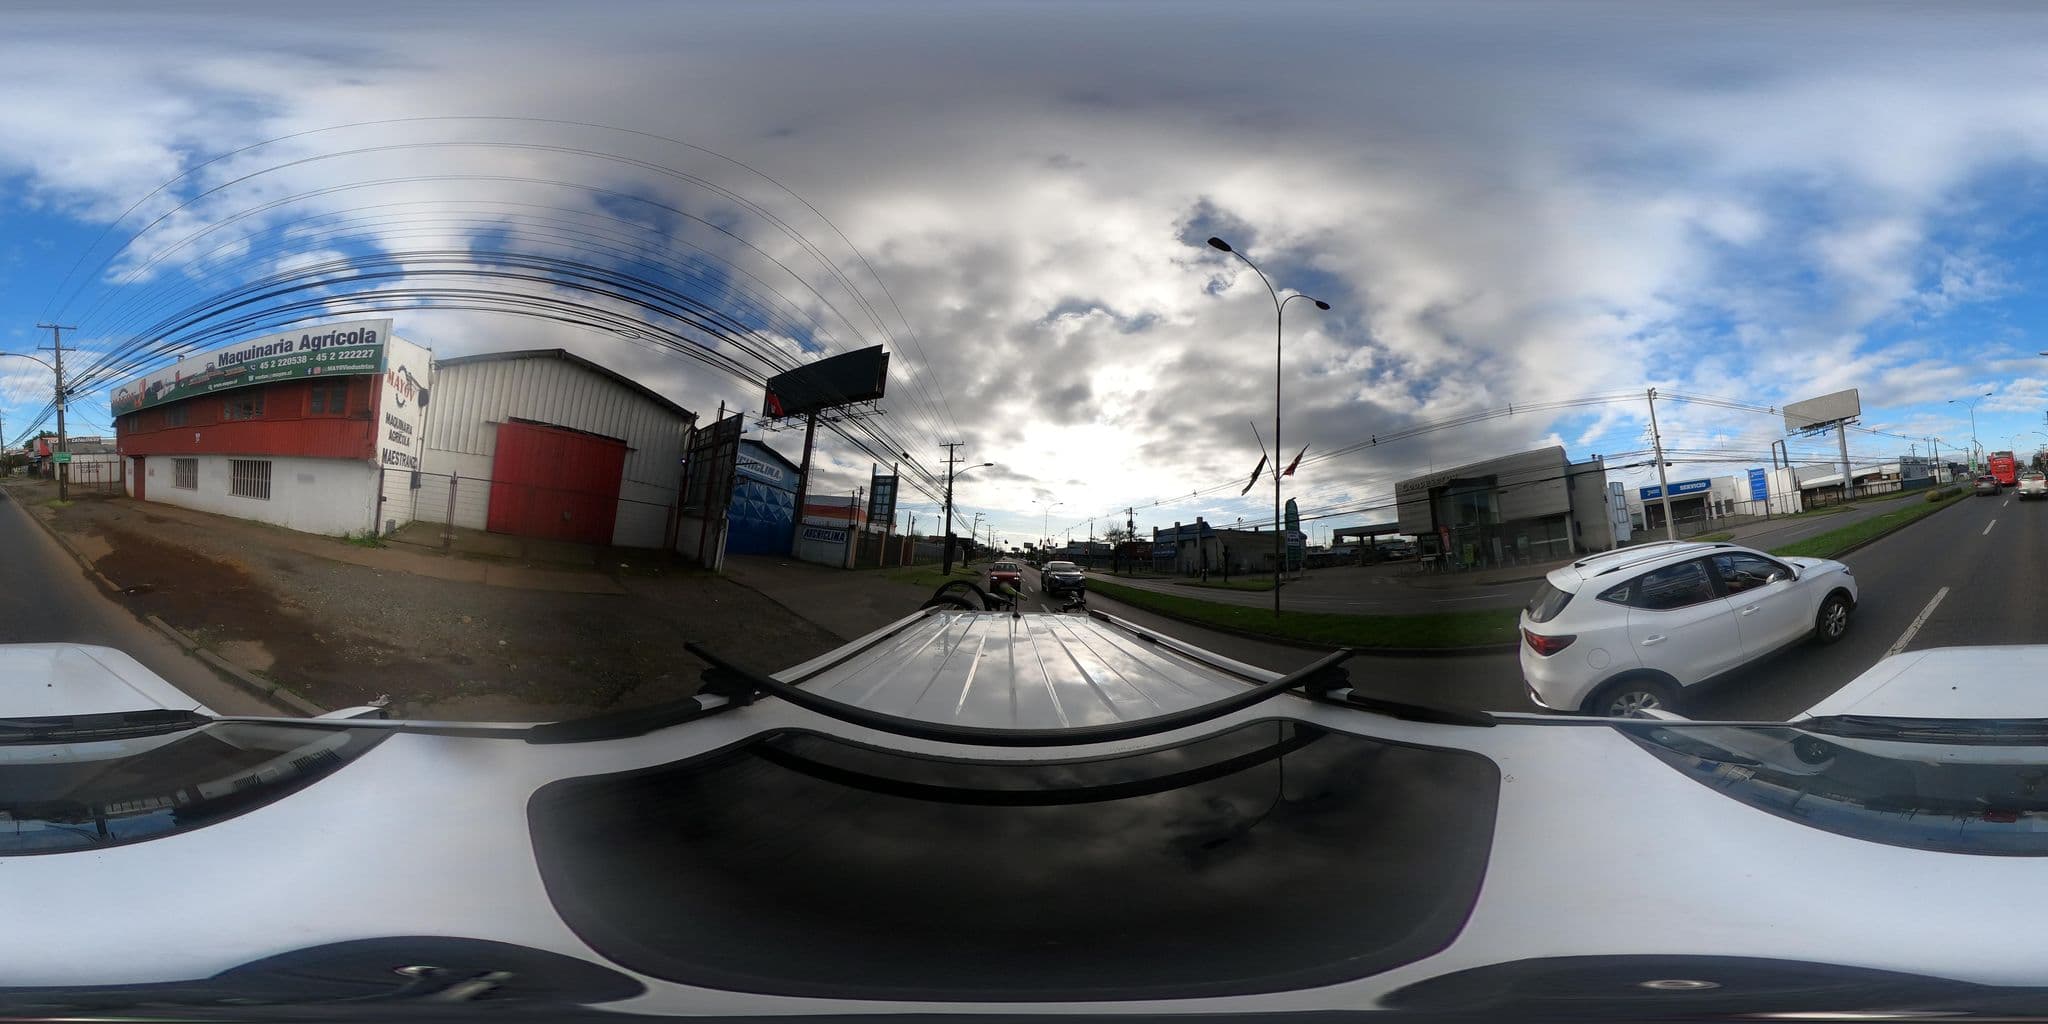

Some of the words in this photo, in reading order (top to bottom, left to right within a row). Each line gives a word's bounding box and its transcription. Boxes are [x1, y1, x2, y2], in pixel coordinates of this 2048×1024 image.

[218, 339, 293, 368] Maquinaria
[298, 327, 377, 353] Agrícola
[260, 361, 268, 370] 45
[270, 360, 276, 368] 2
[316, 352, 327, 362] 45
[329, 352, 336, 360] 2
[338, 349, 375, 360] 222227
[1680, 482, 1706, 491] SERVICIO
